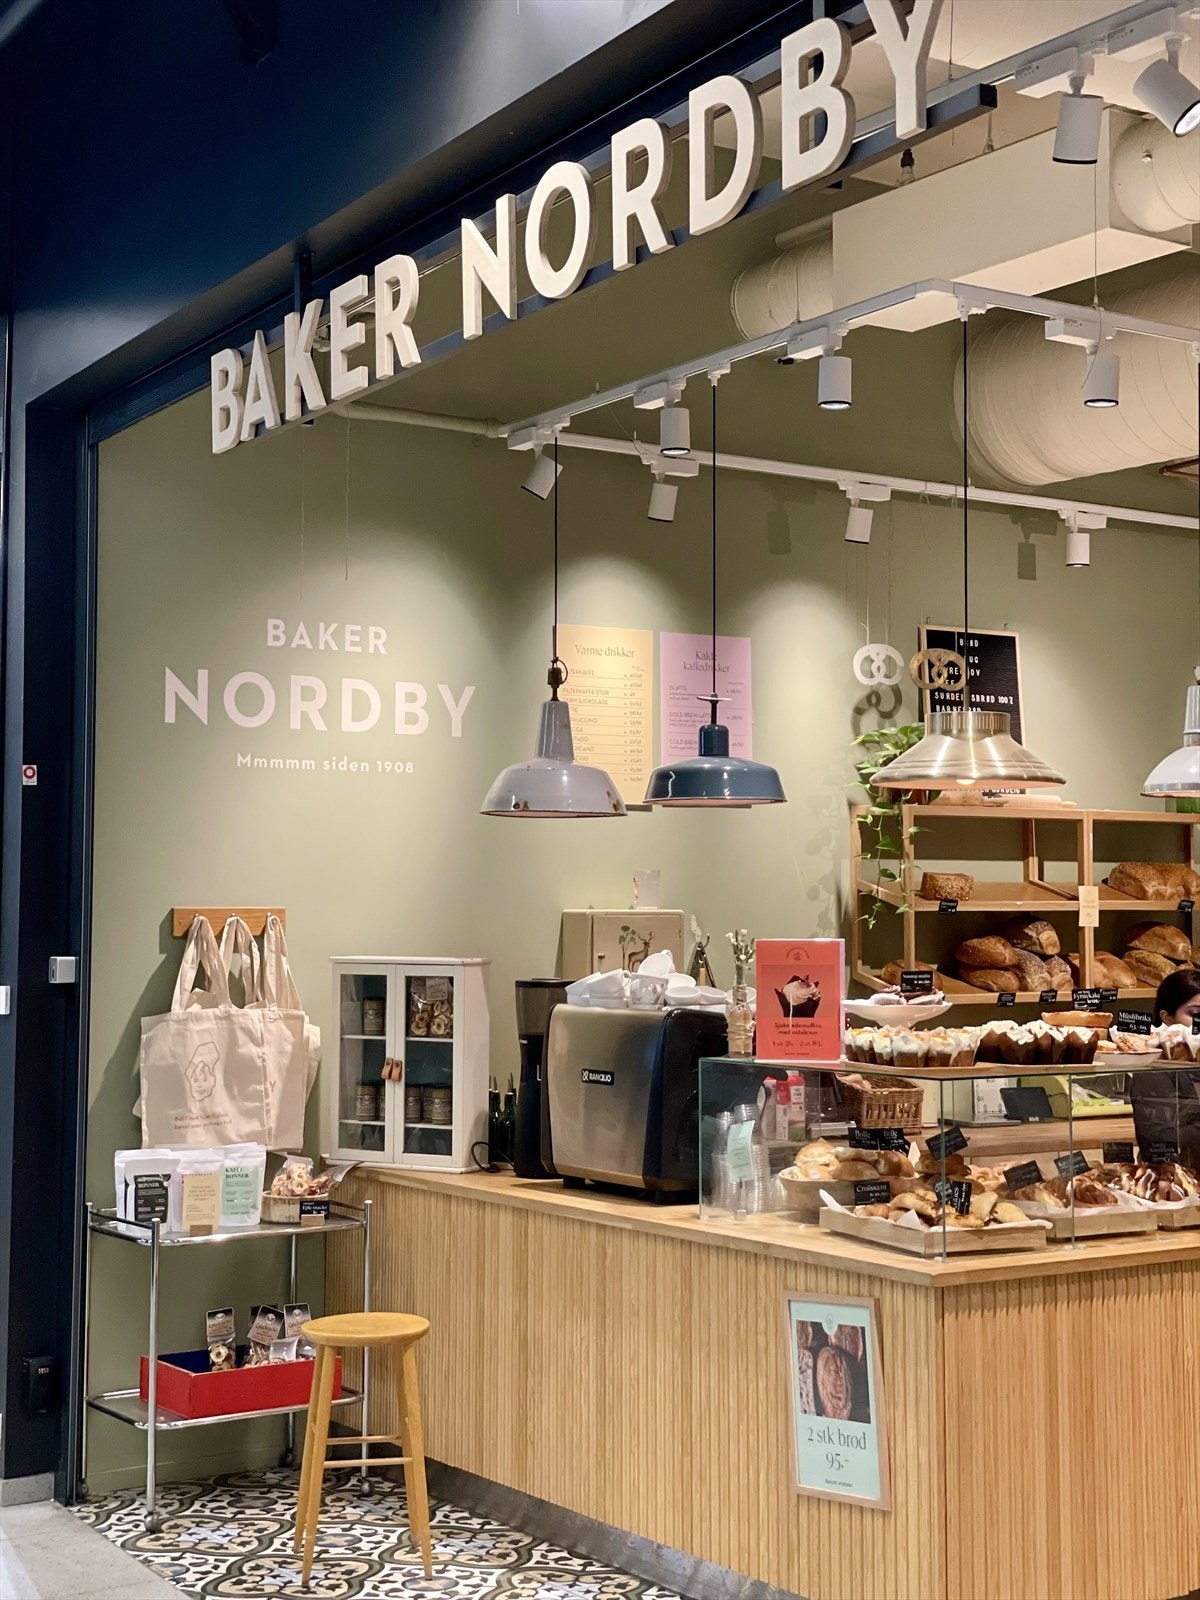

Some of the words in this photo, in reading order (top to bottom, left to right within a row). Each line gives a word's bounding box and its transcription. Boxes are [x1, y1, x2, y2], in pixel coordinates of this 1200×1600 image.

[211, 254, 422, 454] BAKER
[461, 0, 942, 340] NORDBY
[266, 618, 388, 654] BAKER
[574, 643, 604, 656] Varme
[604, 646, 635, 658] drikker
[164, 666, 476, 737] NORDBY
[237, 752, 316, 770] Mmmmm
[322, 756, 370, 772] siden
[376, 760, 415, 774] 1908
[807, 1427, 814, 1441] 2
[816, 1426, 834, 1445] stk
